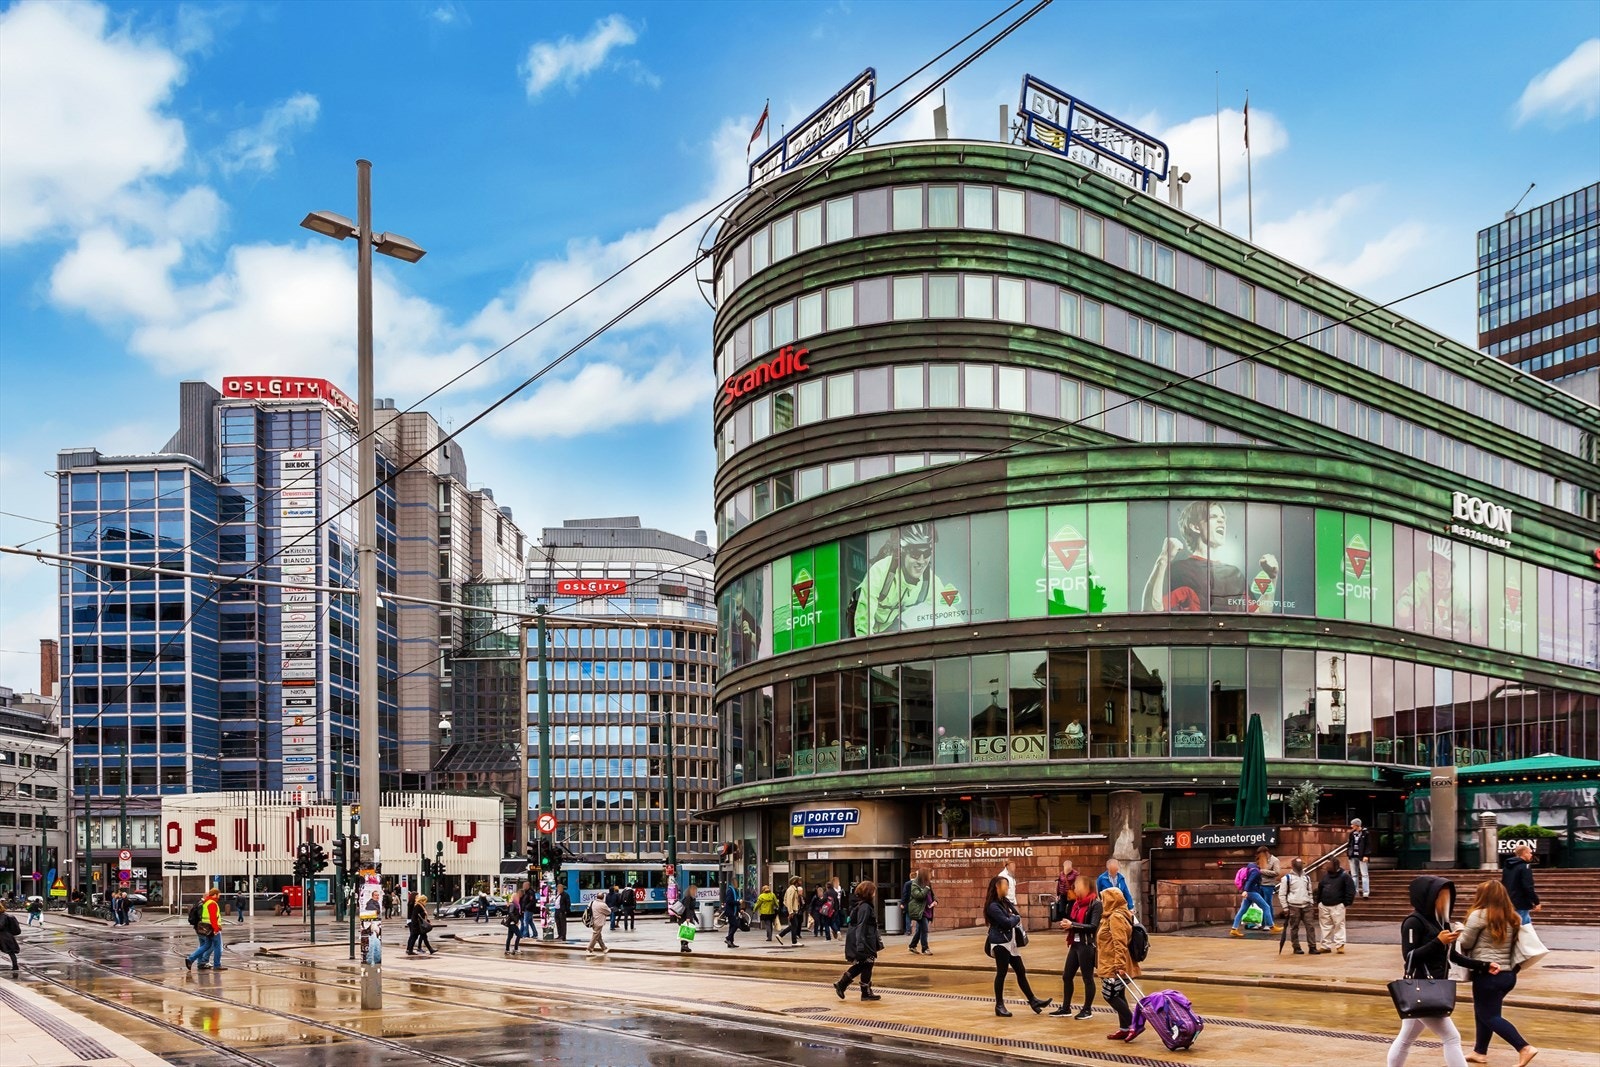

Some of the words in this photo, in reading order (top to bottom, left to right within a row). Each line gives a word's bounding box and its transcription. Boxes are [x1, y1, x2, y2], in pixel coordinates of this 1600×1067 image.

[724, 345, 810, 406] Scandic
[1452, 490, 1513, 535] EGON
[1451, 524, 1512, 550] RESTAURANT
[1035, 575, 1101, 593] SPORT
[1336, 581, 1379, 601] SPORT
[1227, 598, 1246, 606] EKTE
[786, 610, 822, 631] SPORT
[917, 614, 935, 622] EKTE
[974, 735, 1046, 755] EGON
[797, 750, 838, 766] EGON
[793, 814, 803, 824] BY
[807, 826, 841, 835] shopping
[1193, 832, 1266, 846] Jernbanetorget
[1497, 838, 1538, 850] EGON
[914, 848, 972, 859] BYPORTEN
[974, 846, 1034, 858] SHOPPING
